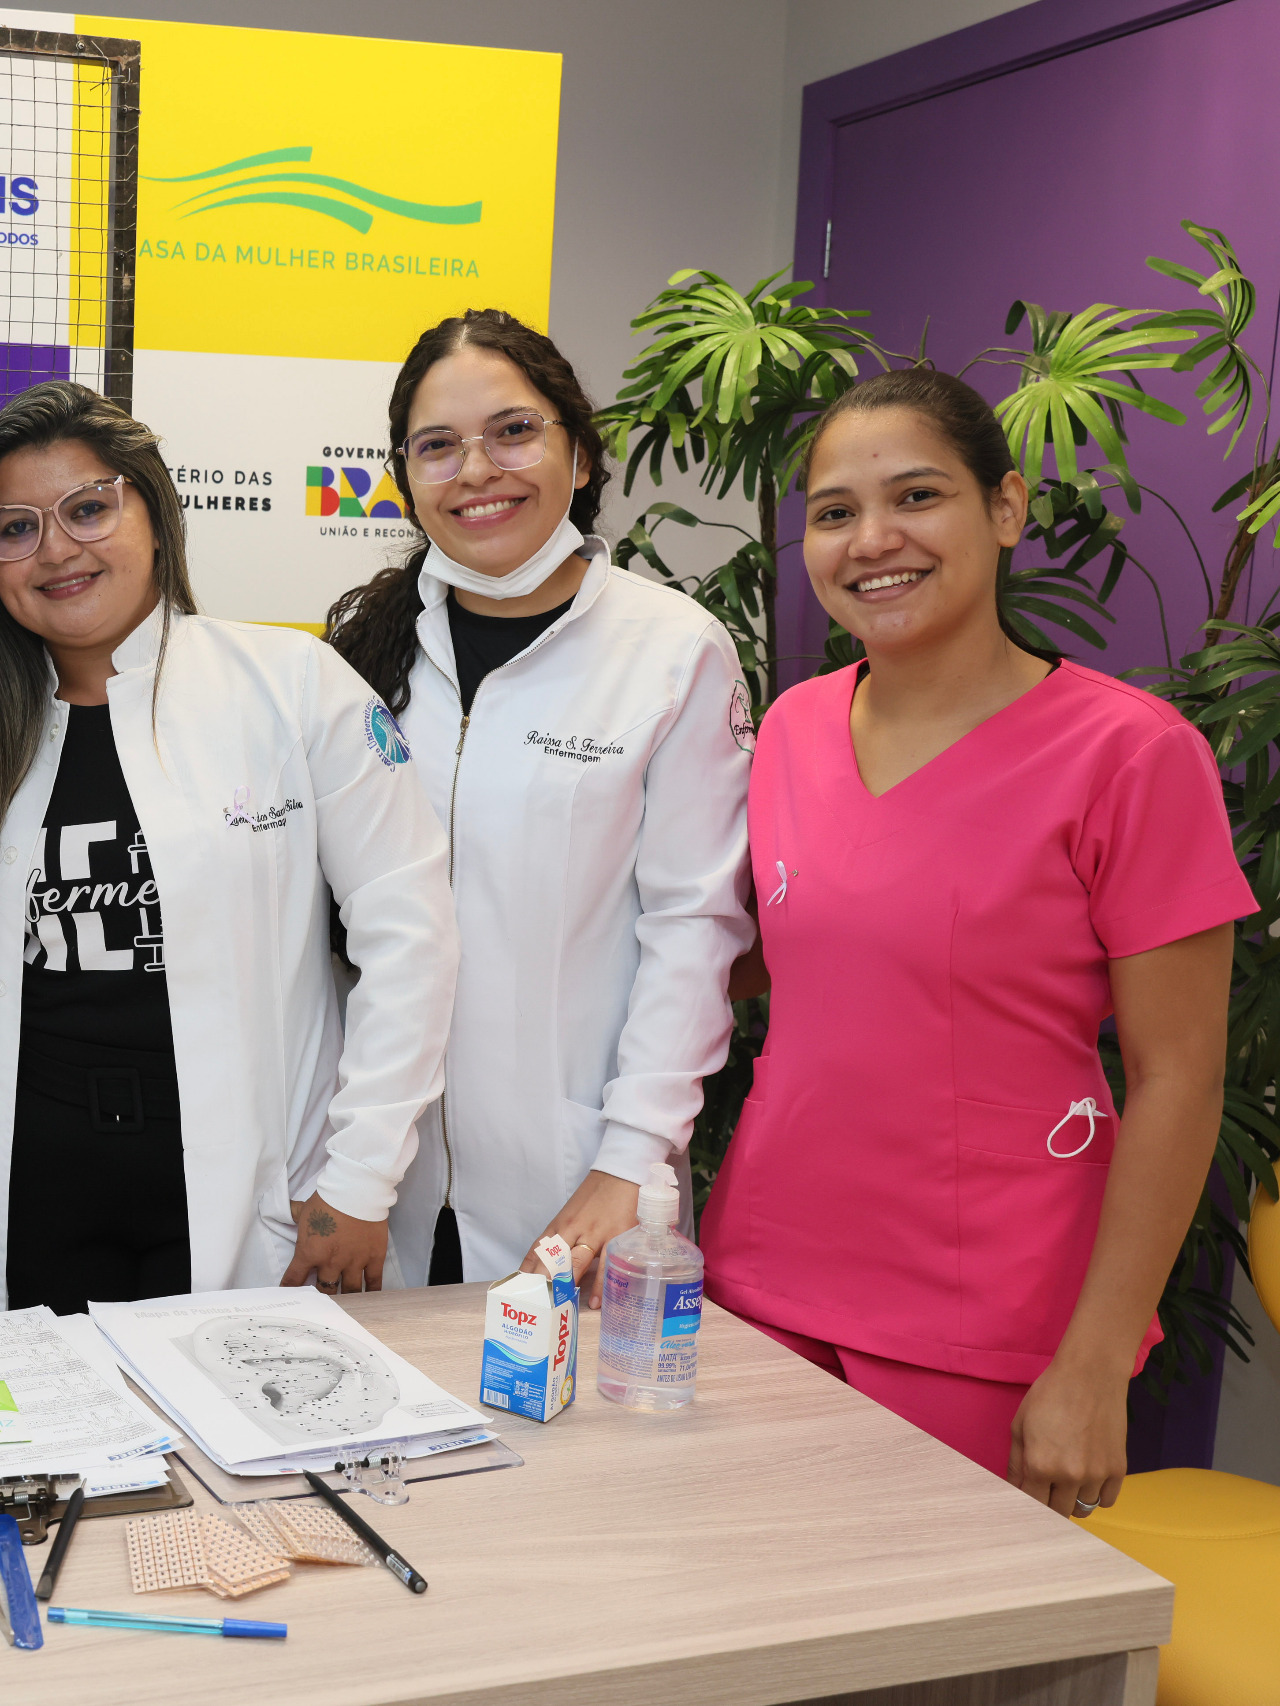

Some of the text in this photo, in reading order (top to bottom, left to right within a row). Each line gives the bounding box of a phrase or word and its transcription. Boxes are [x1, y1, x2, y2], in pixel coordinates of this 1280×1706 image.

[195, 242, 226, 262] DA
[236, 245, 335, 269] MULHER
[345, 252, 480, 278] BRASILEIRA
[323, 446, 393, 459] GOVERN
[235, 470, 272, 486] DAS
[305, 465, 410, 518] BRA
[320, 525, 357, 537] UNIÃO
[363, 528, 369, 537] E
[523, 730, 625, 755] Raissa S. Ferreira
[544, 745, 601, 763] Enfermagem
[375, 747, 396, 773] Centro
[134, 1311, 170, 1319] Mapa
[191, 1305, 232, 1315] Pontos
[234, 1300, 302, 1313] Auriculares
[500, 1301, 537, 1326] Topz
[553, 1309, 570, 1372] Topz
